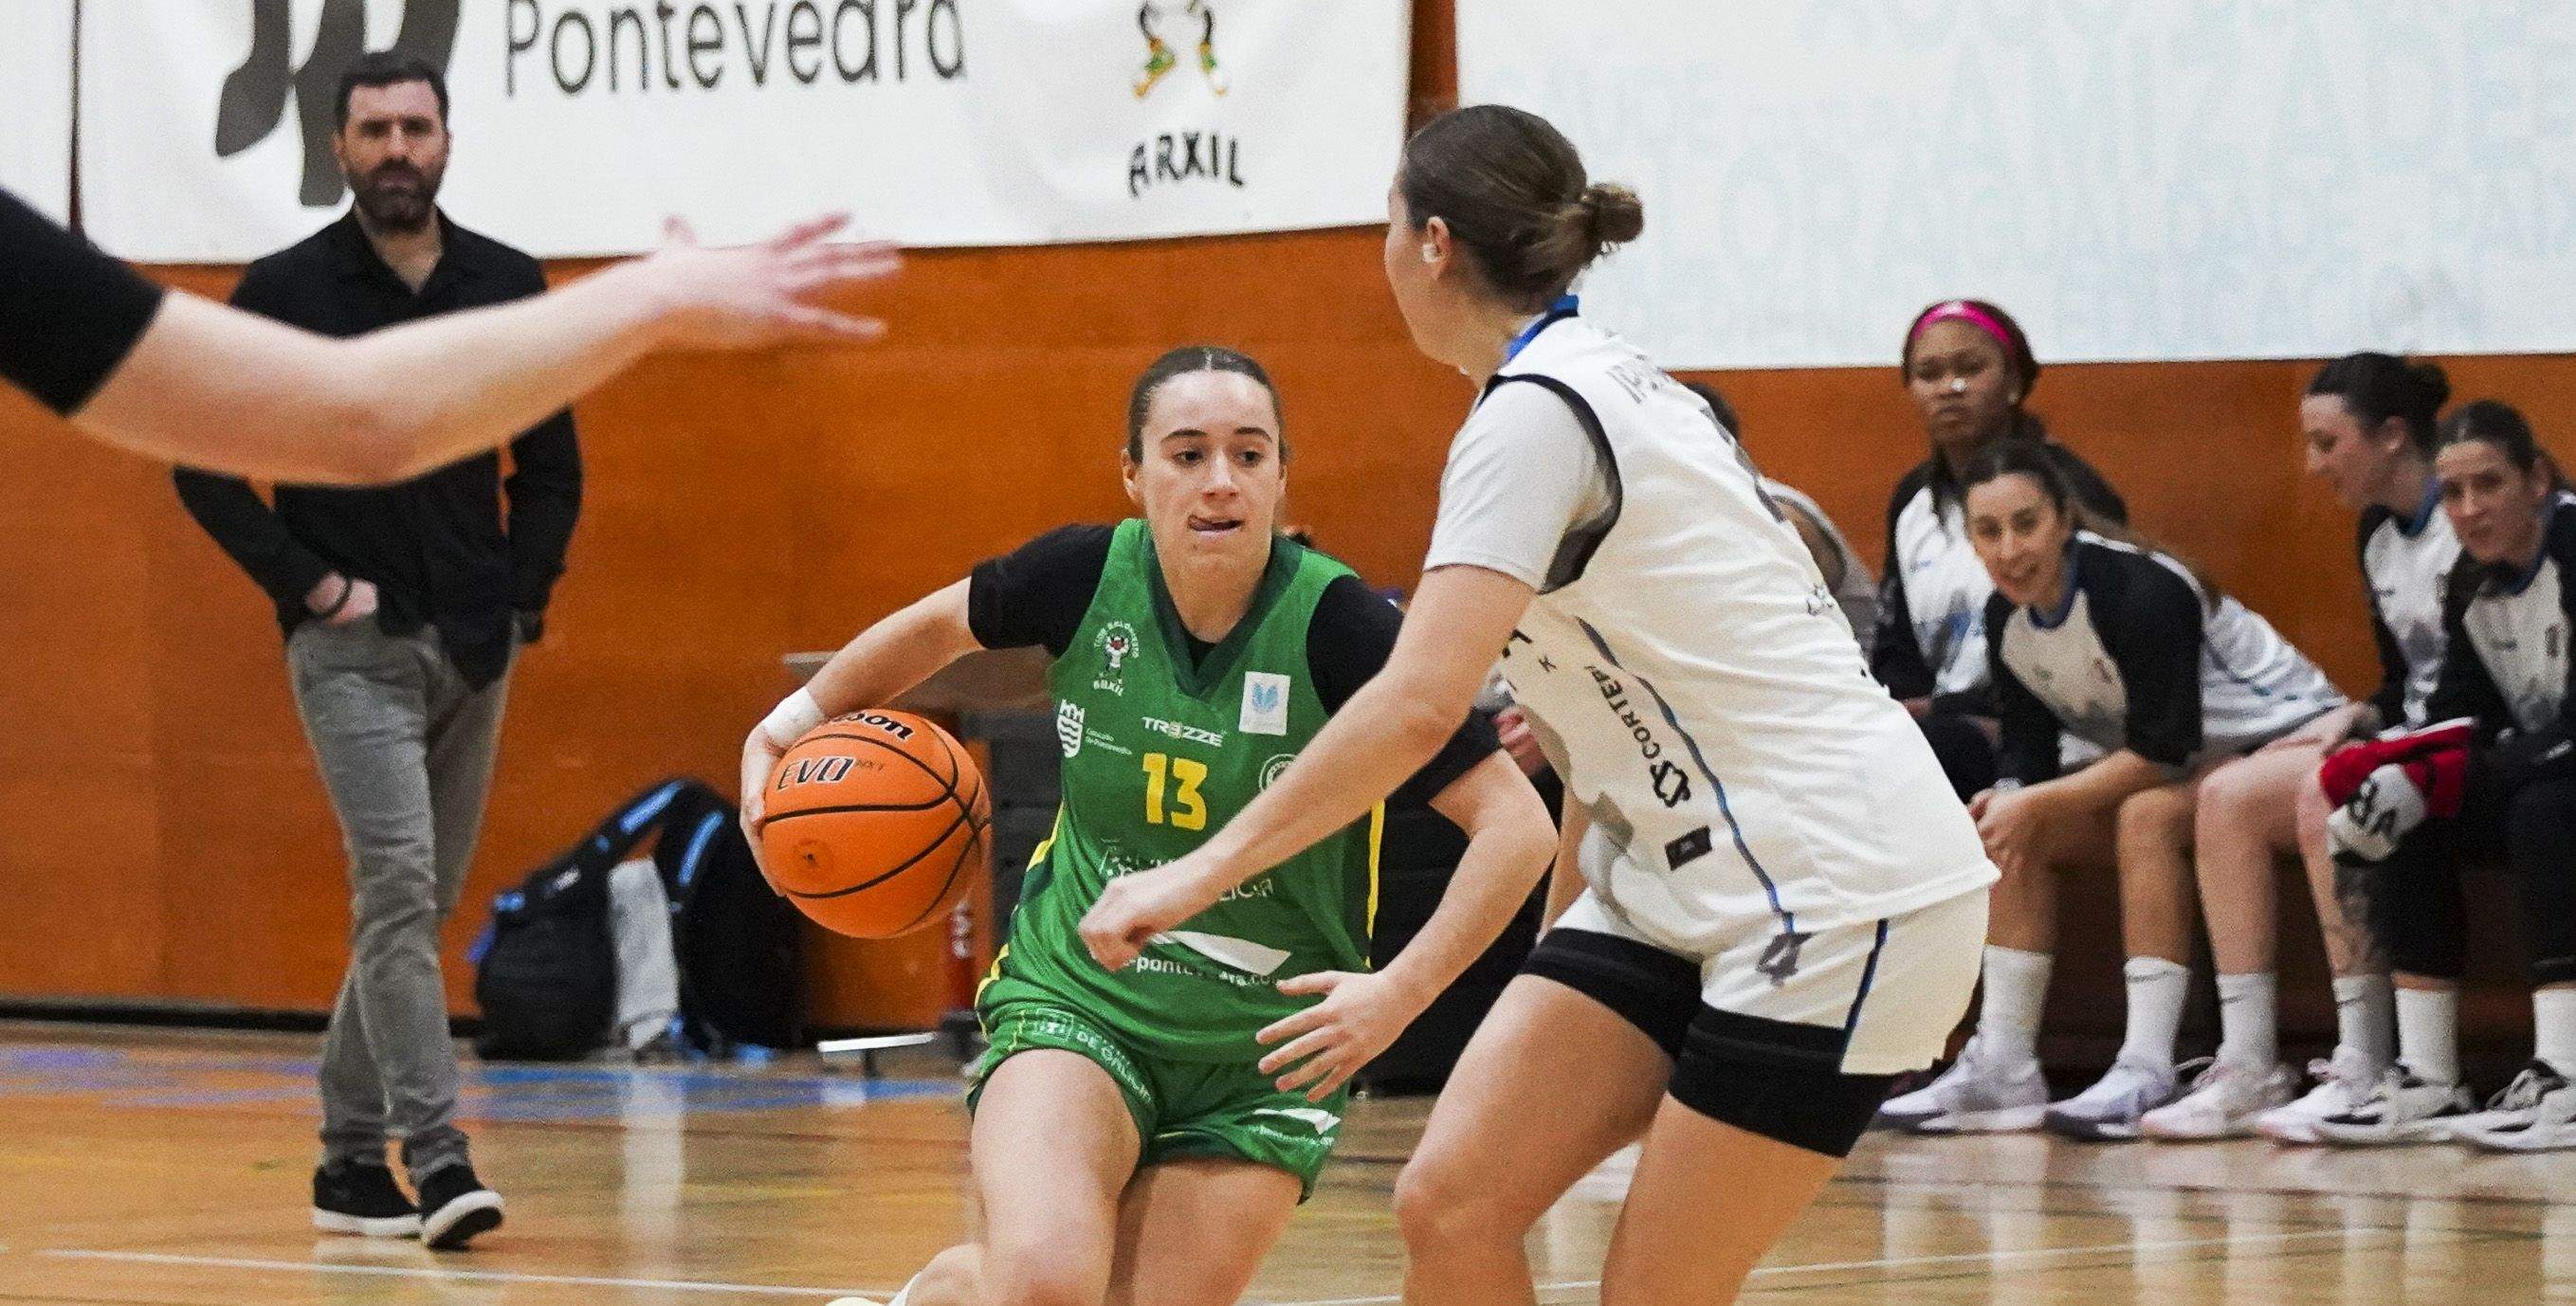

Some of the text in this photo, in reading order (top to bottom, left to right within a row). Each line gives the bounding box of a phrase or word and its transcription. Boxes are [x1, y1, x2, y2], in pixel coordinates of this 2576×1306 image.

[505, 0, 966, 96] Pontevedra
[1127, 129, 1246, 198] ARXIL
[776, 756, 854, 791] EVO
[1142, 753, 1209, 831] 13
